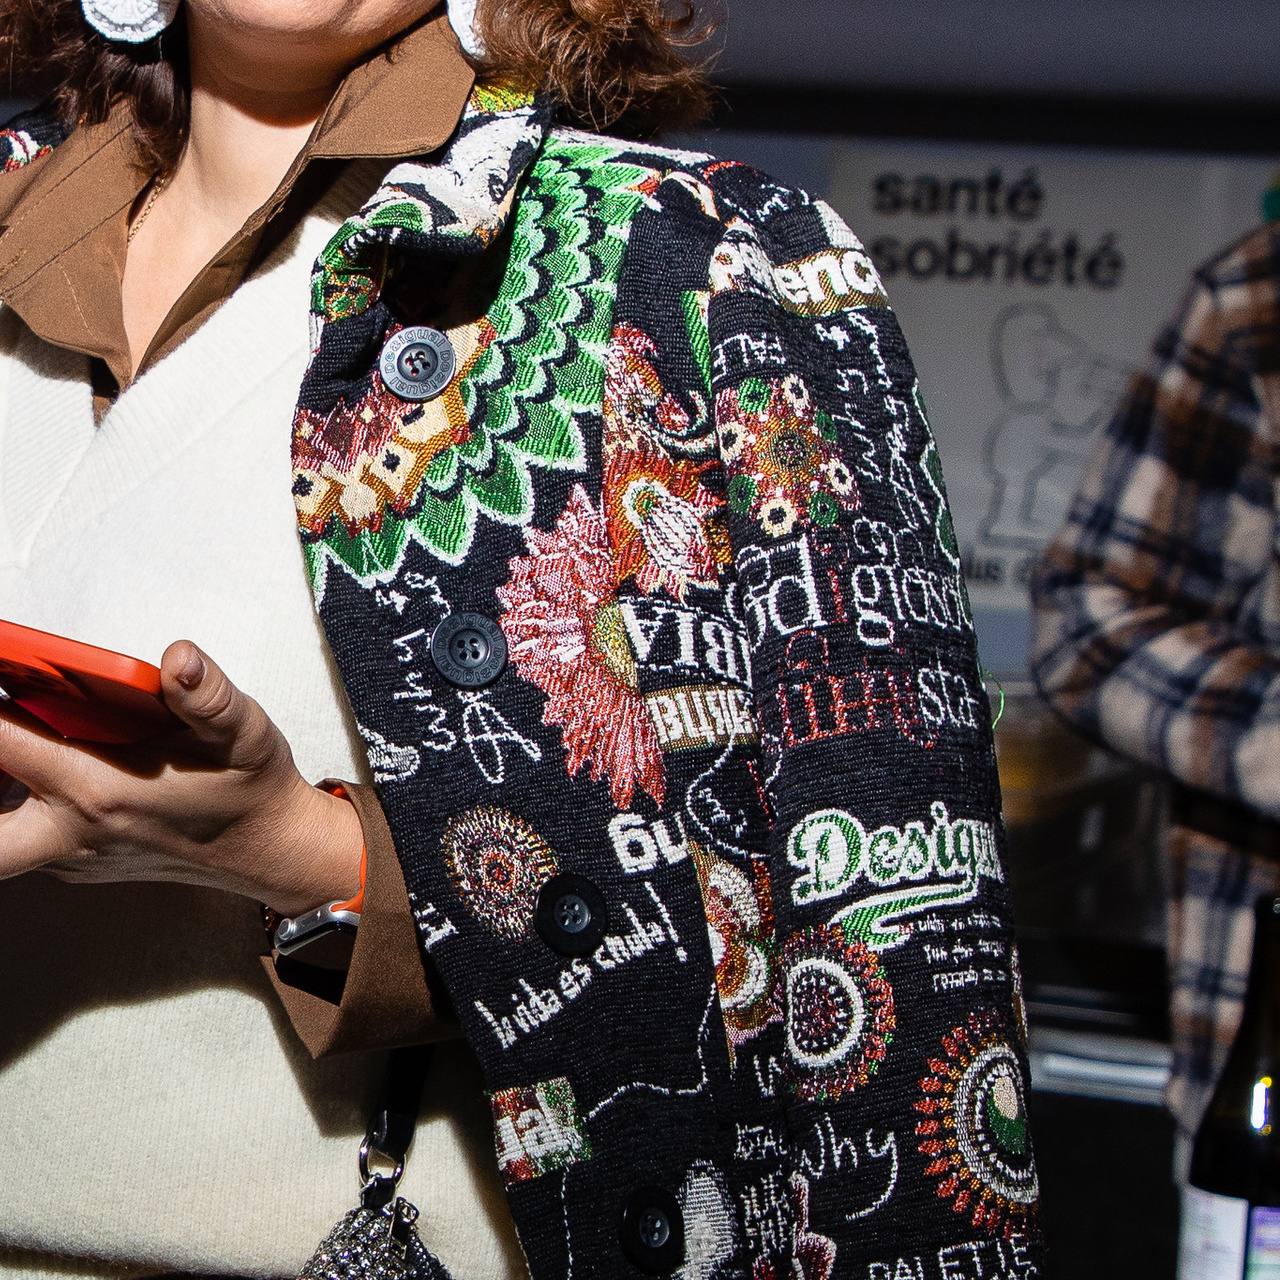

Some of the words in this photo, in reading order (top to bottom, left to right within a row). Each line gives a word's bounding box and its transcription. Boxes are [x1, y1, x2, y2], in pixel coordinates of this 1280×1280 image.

[873, 167, 1045, 220] santé
[870, 228, 1126, 289] sobriété
[512, 978, 565, 1034] vida
[560, 957, 593, 1000] es
